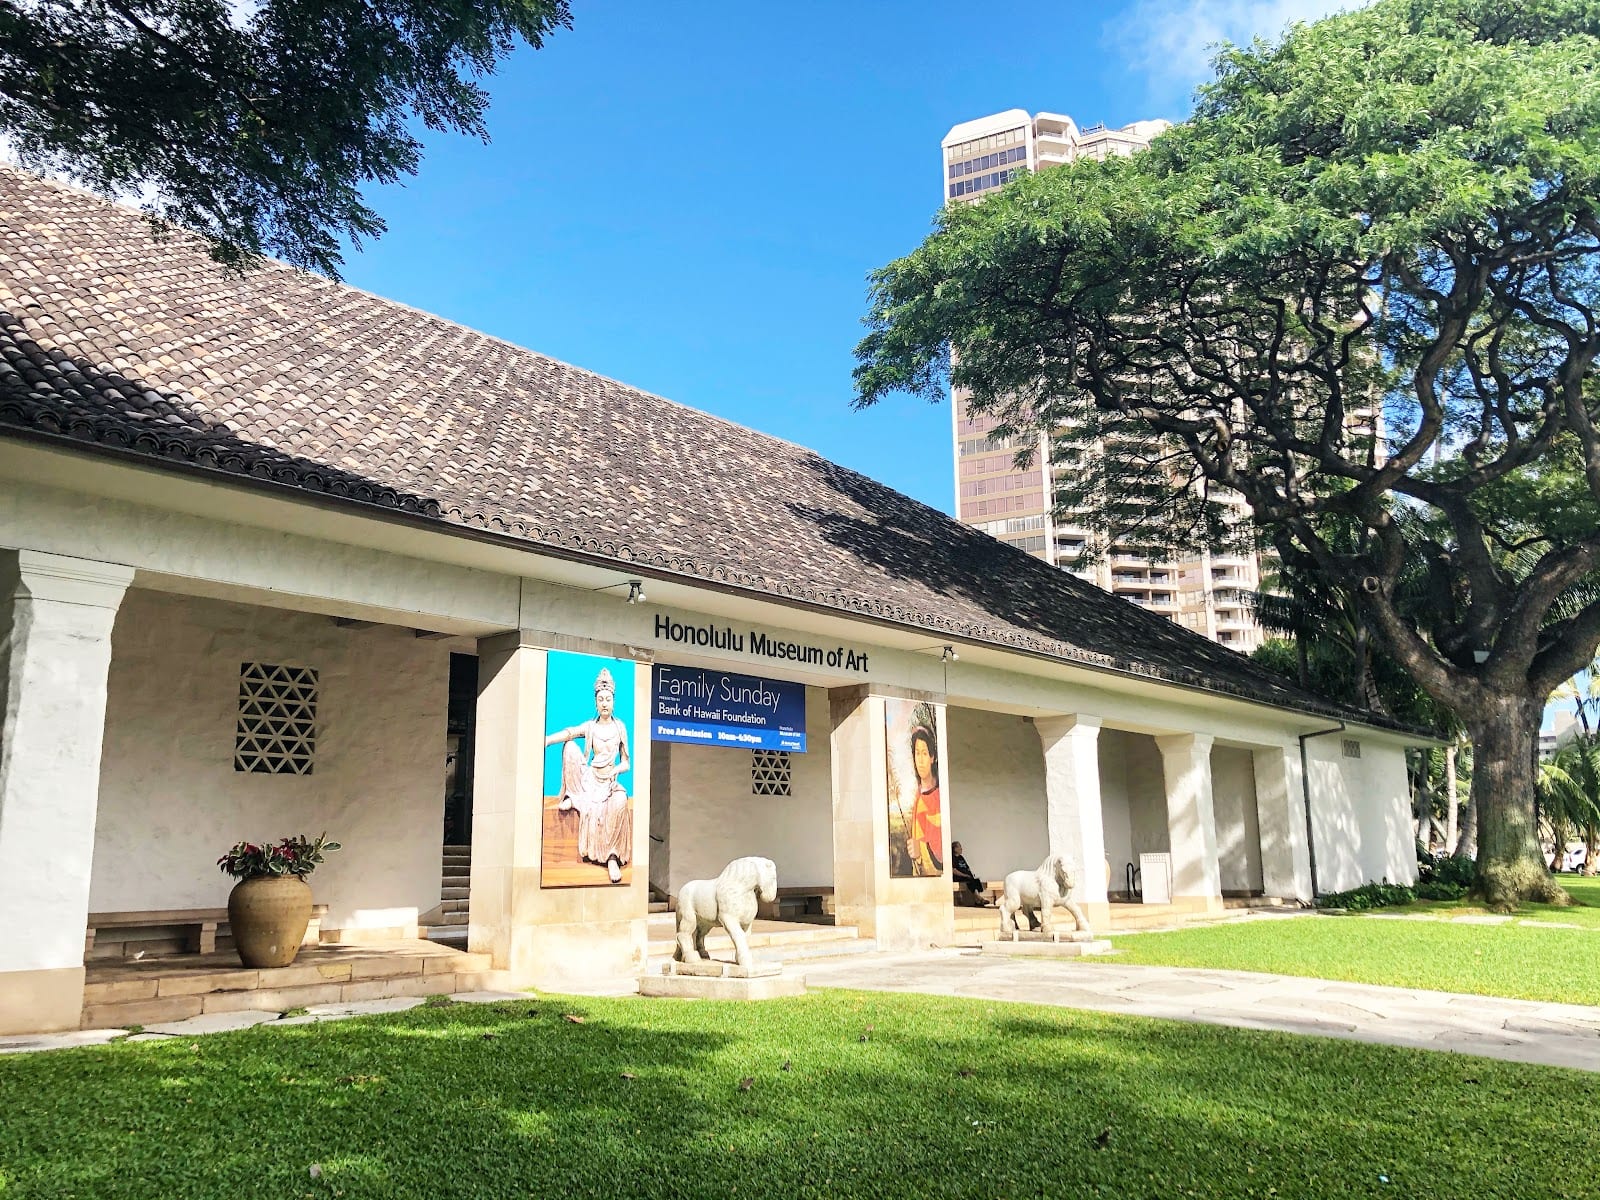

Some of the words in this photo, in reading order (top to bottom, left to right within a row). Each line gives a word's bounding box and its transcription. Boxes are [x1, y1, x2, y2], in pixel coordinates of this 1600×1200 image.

[655, 614, 743, 652] Honolulu
[750, 632, 823, 665] Museum
[827, 647, 843, 667] of
[845, 649, 869, 672] Art
[659, 668, 715, 705] Family
[720, 676, 781, 713] Sunday
[658, 702, 681, 716] Bank
[683, 705, 692, 717] of
[694, 706, 721, 720] Hawaii
[722, 710, 766, 725] Foundation
[657, 726, 675, 736] Free
[675, 728, 712, 739] Admission
